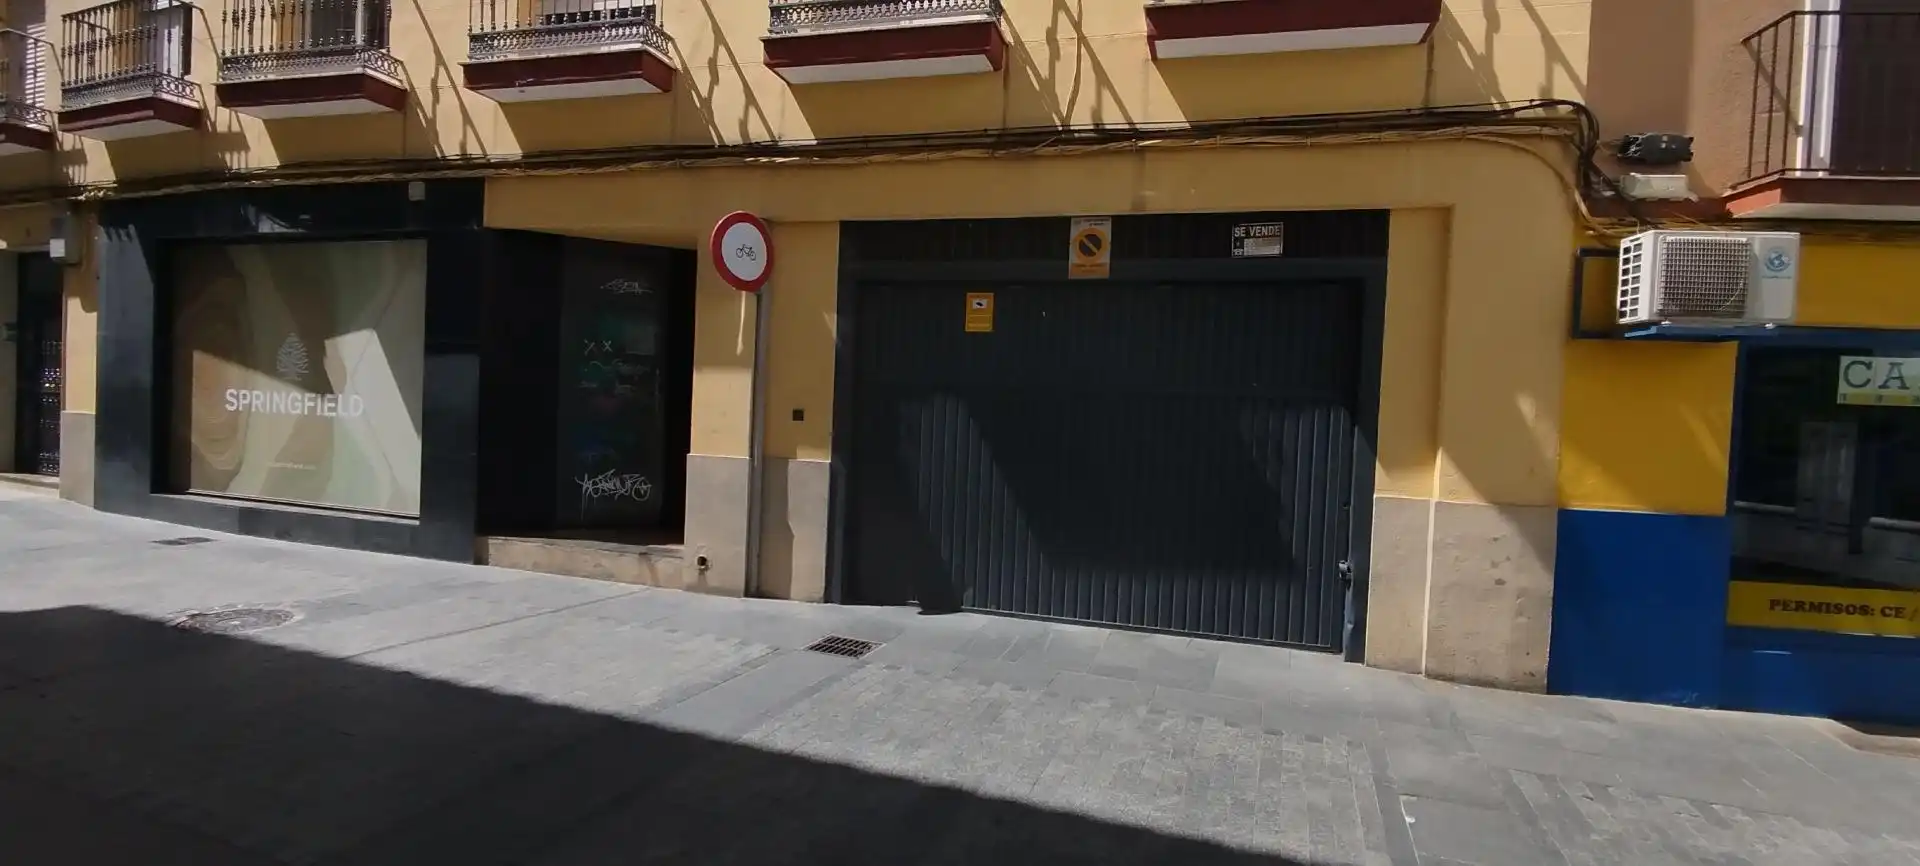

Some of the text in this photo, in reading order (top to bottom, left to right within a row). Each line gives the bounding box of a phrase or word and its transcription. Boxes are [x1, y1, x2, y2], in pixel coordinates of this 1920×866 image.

[1234, 225, 1281, 237] SE VENDE
[225, 388, 364, 417] SPRINGFIELD
[1768, 599, 1876, 616] PERMISOS:
[1880, 605, 1907, 619] CE
